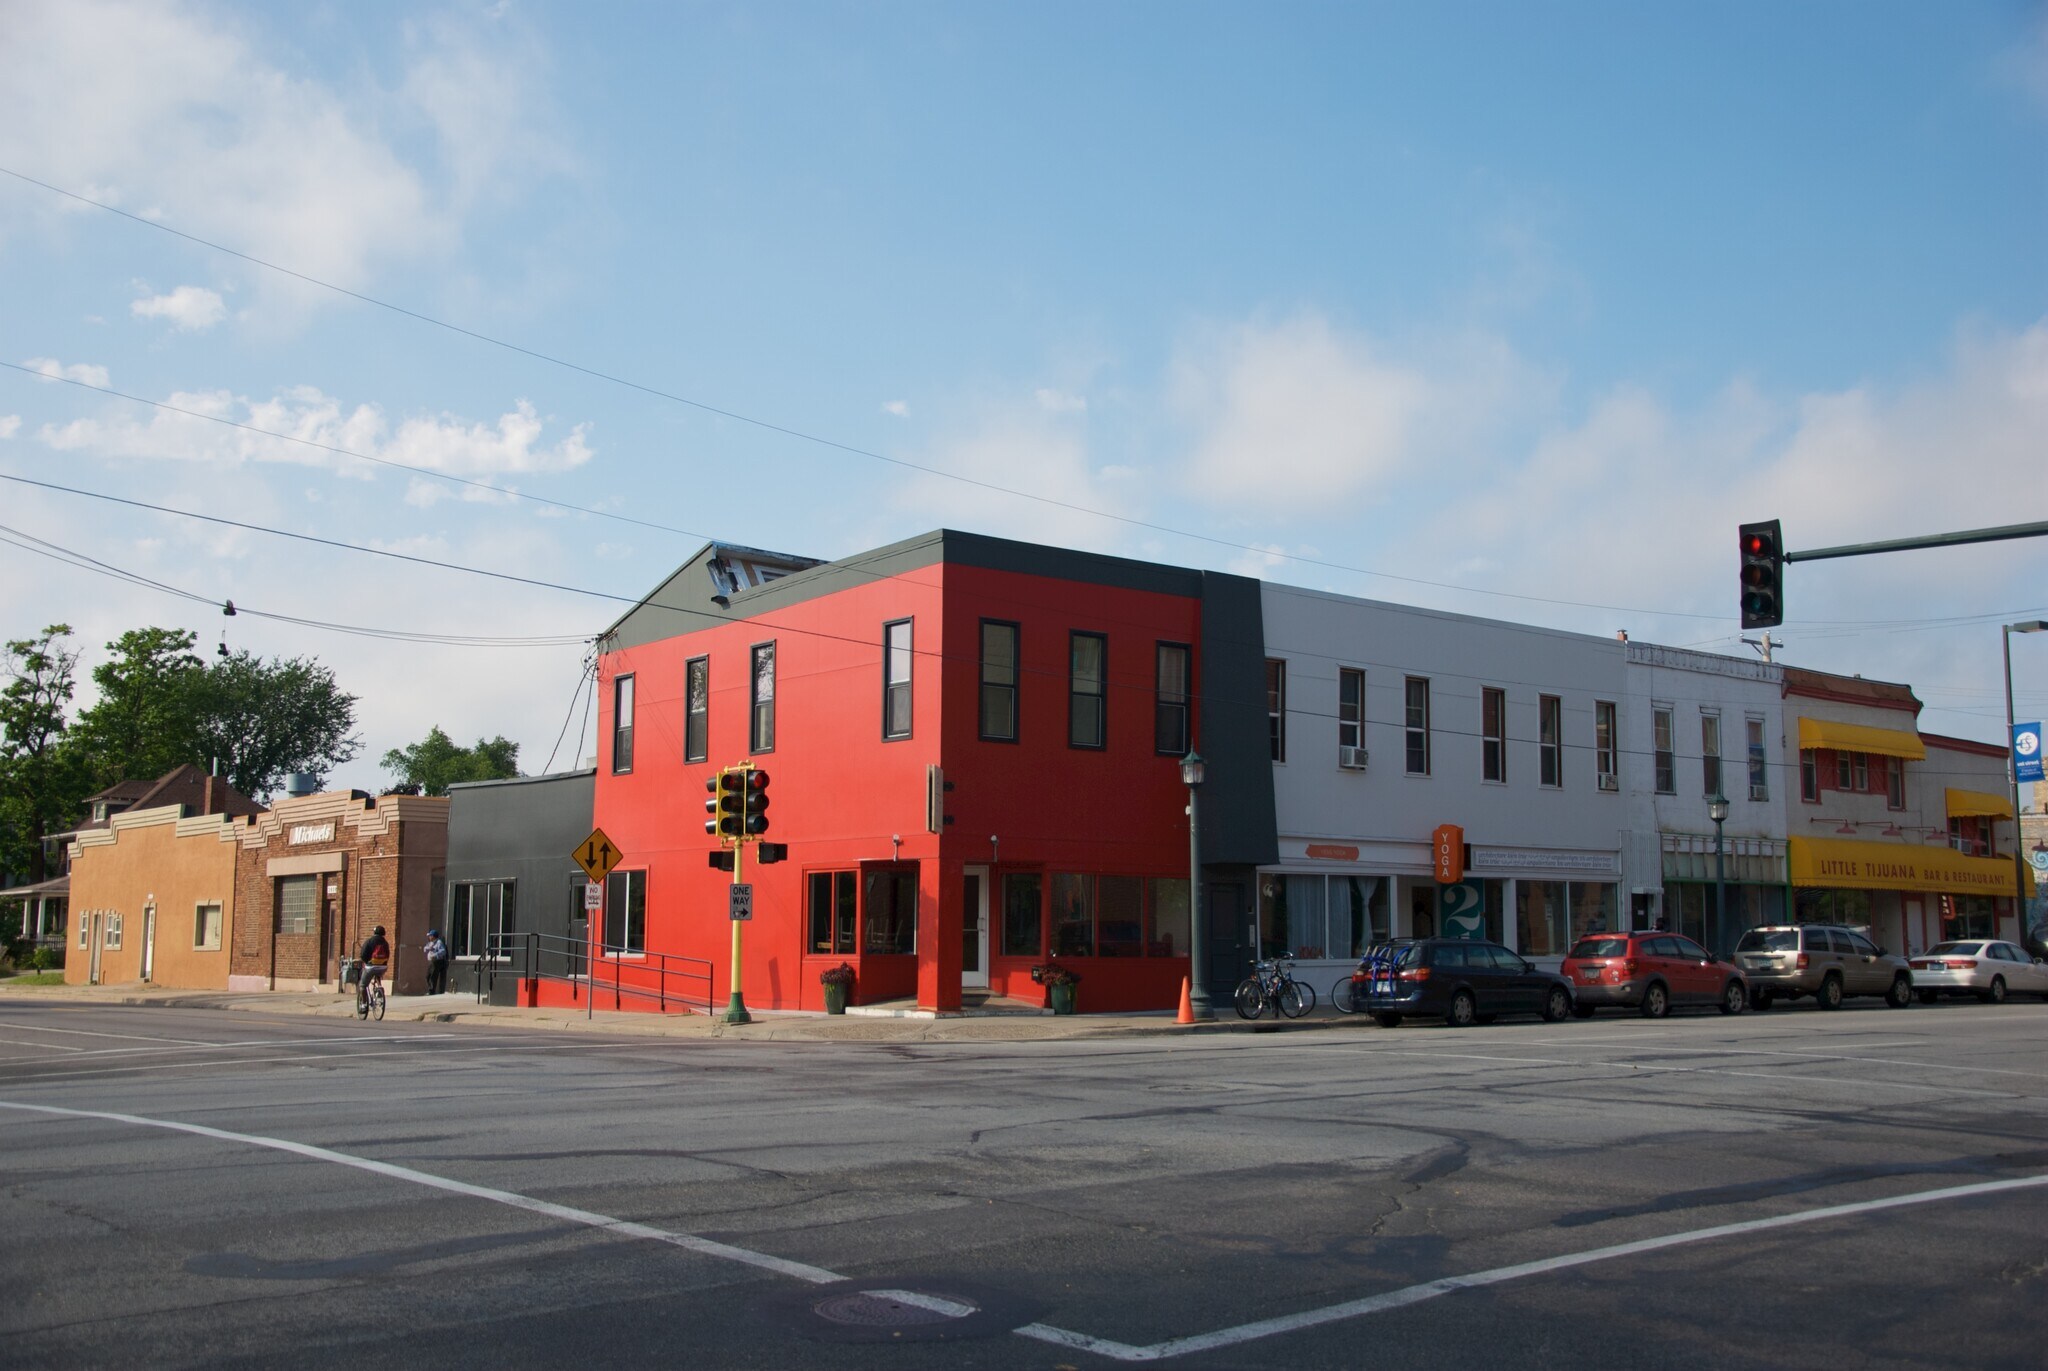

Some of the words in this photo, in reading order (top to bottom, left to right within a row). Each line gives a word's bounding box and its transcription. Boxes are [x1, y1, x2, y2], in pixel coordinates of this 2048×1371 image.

[293, 824, 331, 845] Michaels
[1441, 833, 1450, 877] YOGA
[1821, 860, 1857, 876] LITTLE
[1865, 862, 1916, 879] TIJUANA
[1924, 869, 1940, 881] BAR
[1944, 871, 1949, 882] &
[1952, 871, 2005, 886] RESTAURANT
[733, 886, 750, 896] ONE
[733, 896, 750, 905] WAY
